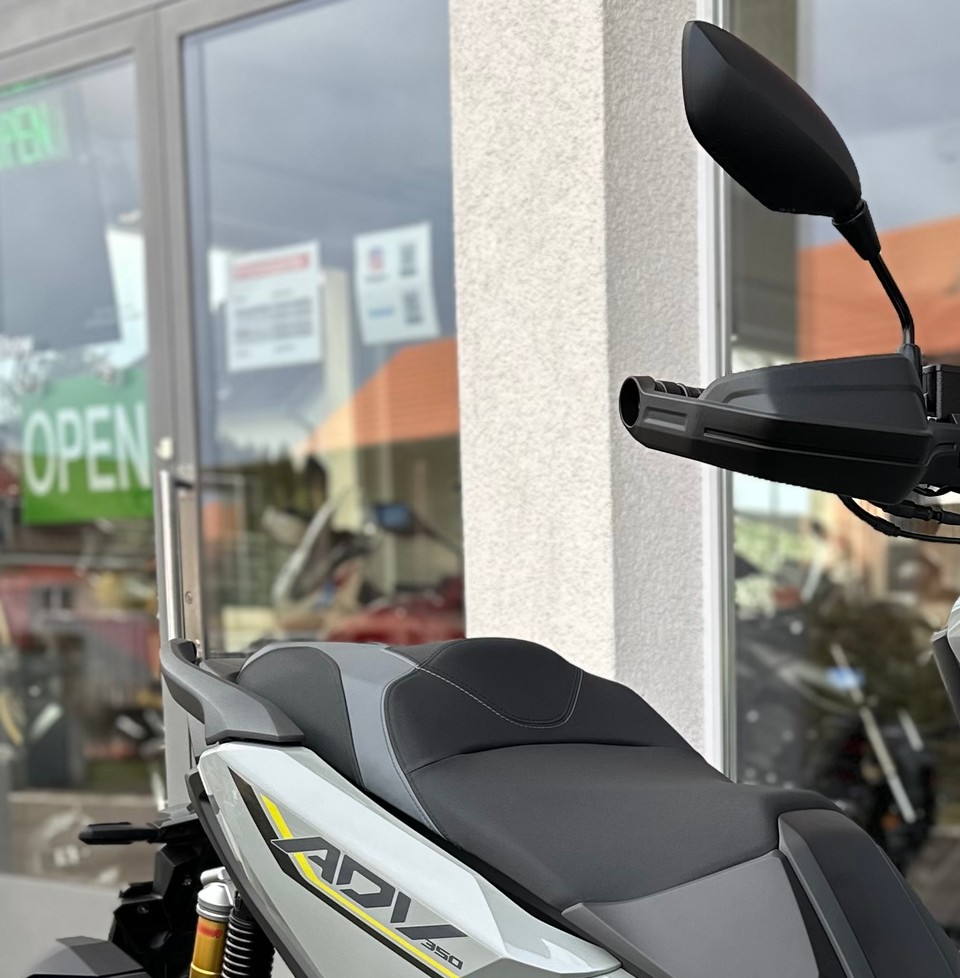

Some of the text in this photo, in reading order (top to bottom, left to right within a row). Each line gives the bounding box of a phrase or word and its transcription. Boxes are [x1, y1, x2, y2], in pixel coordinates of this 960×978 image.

[22, 401, 150, 497] OPEN
[271, 837, 468, 940] ADV
[420, 938, 464, 970] 350
